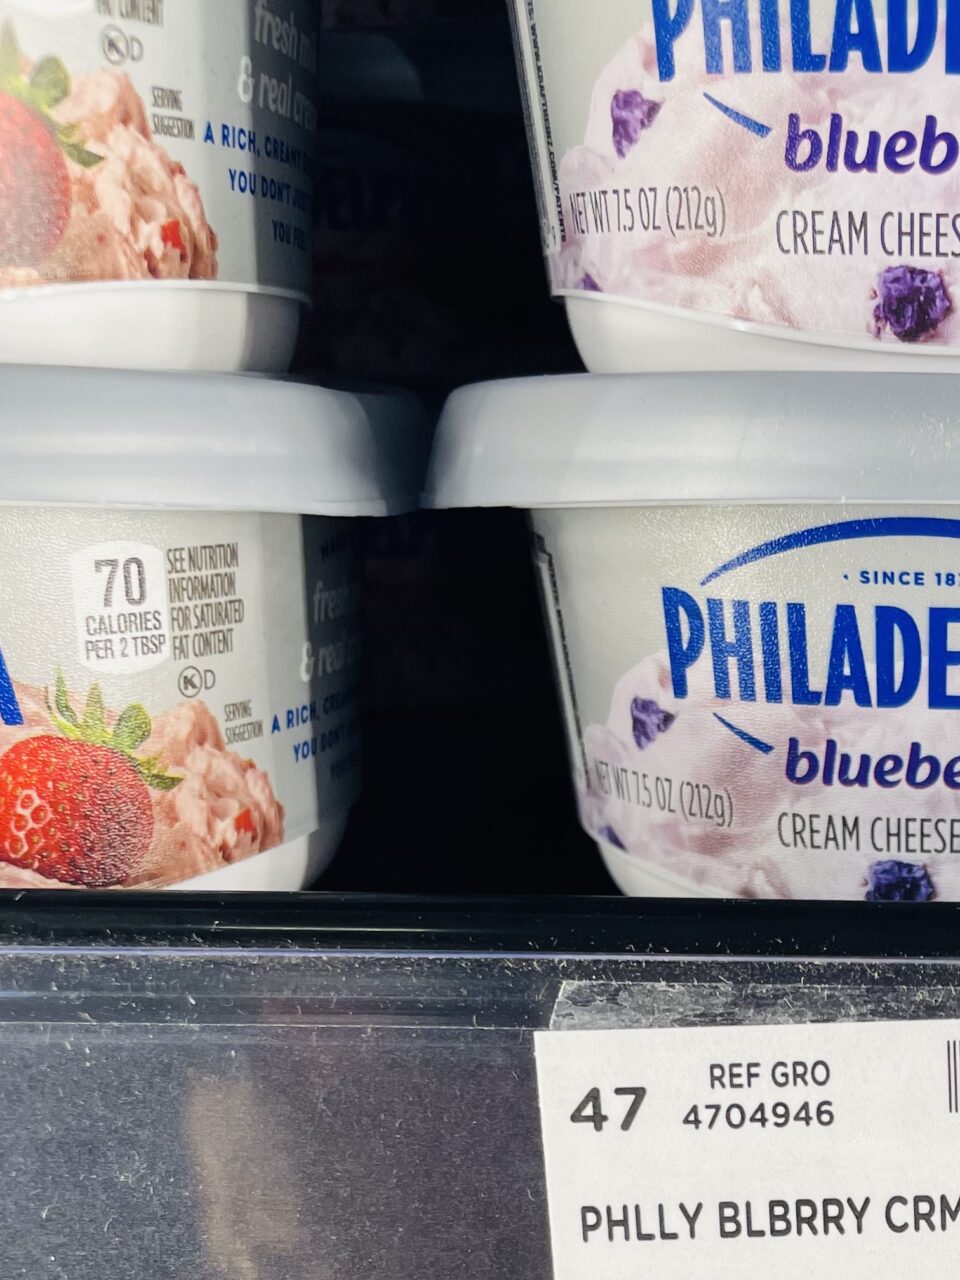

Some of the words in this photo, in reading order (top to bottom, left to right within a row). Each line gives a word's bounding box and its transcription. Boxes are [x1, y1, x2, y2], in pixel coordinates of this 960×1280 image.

[203, 121, 215, 145] A
[228, 168, 258, 195] YOU
[611, 187, 634, 234] 7.5
[638, 186, 662, 232] OZ
[666, 184, 727, 238] (212g)
[775, 209, 869, 257] CREAM
[166, 546, 186, 574] SEE
[186, 542, 240, 572] NUTRITION
[93, 556, 148, 608] 70
[168, 572, 237, 604] INFORMATION
[858, 570, 926, 587] SINCE
[85, 610, 163, 637] CALORIES
[171, 607, 193, 634] FOR
[193, 598, 246, 630] SATURATED
[85, 637, 114, 662] PER
[119, 636, 131, 659] 2
[133, 632, 167, 657] TBSP
[172, 634, 190, 662] FAT
[192, 628, 235, 658] CONTENT
[271, 713, 281, 734] A
[292, 740, 318, 764] YOU
[632, 770, 654, 809] 7.5
[655, 775, 677, 813] OZ
[678, 780, 735, 828] (212g)
[777, 811, 861, 853] CREAM
[709, 1062, 762, 1090] REF
[770, 1060, 832, 1088] GRO
[570, 1086, 648, 1132] 47
[681, 1100, 836, 1131] 4704946
[580, 1201, 703, 1243] PHLLY
[717, 1196, 872, 1239] BLBRRY
